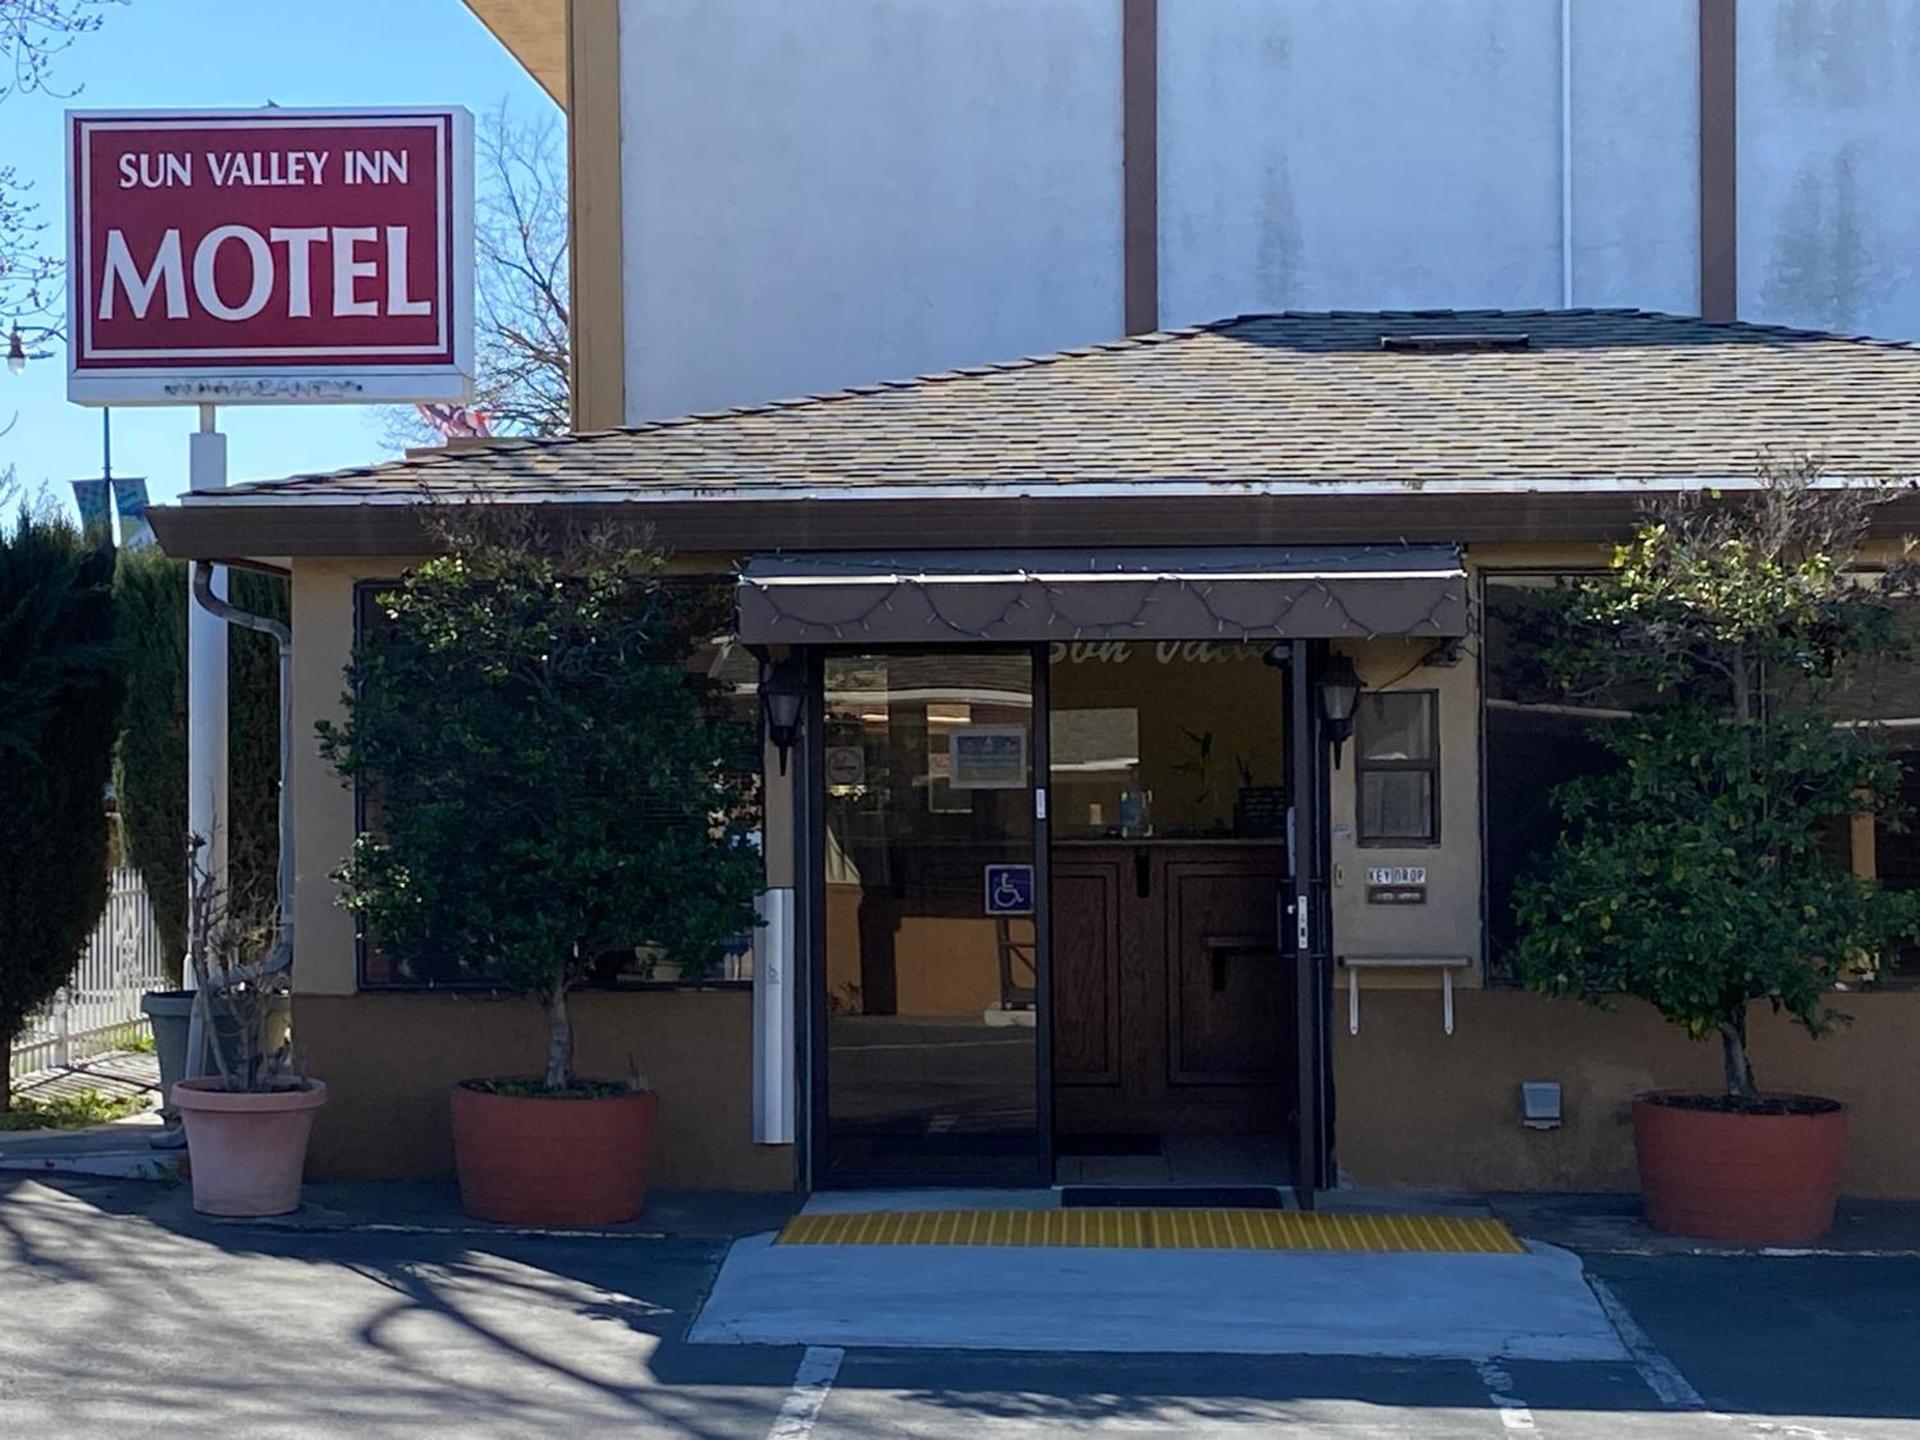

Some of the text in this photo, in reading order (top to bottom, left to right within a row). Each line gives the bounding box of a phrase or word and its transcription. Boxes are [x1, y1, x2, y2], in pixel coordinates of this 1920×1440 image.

[119, 150, 408, 188] SUN VALLEY INN
[98, 224, 432, 322] MOTEL
